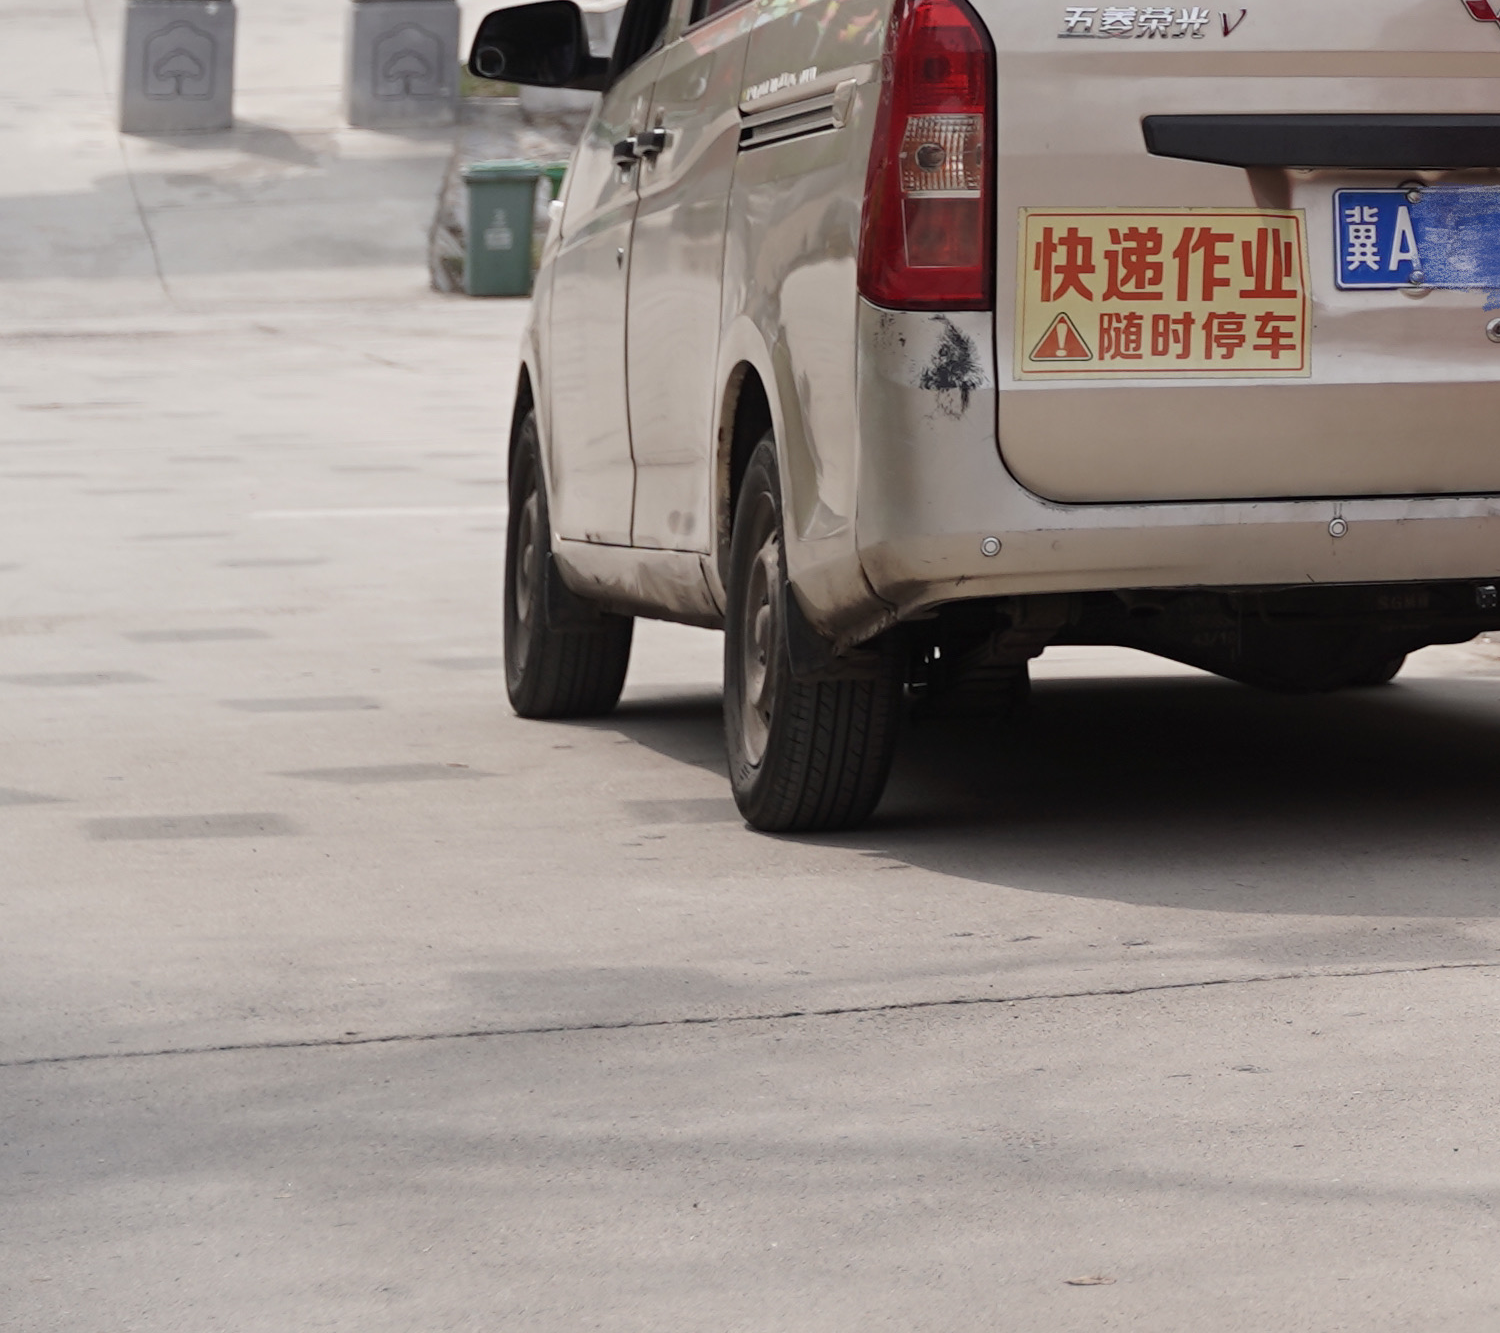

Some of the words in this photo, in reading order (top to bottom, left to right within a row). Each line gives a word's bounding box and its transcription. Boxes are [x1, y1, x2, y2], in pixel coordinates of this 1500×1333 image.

[1057, 6, 1211, 39] 五菱荣光
[1033, 226, 1298, 303] 快递作业
[1098, 312, 1297, 360] 随时停车
